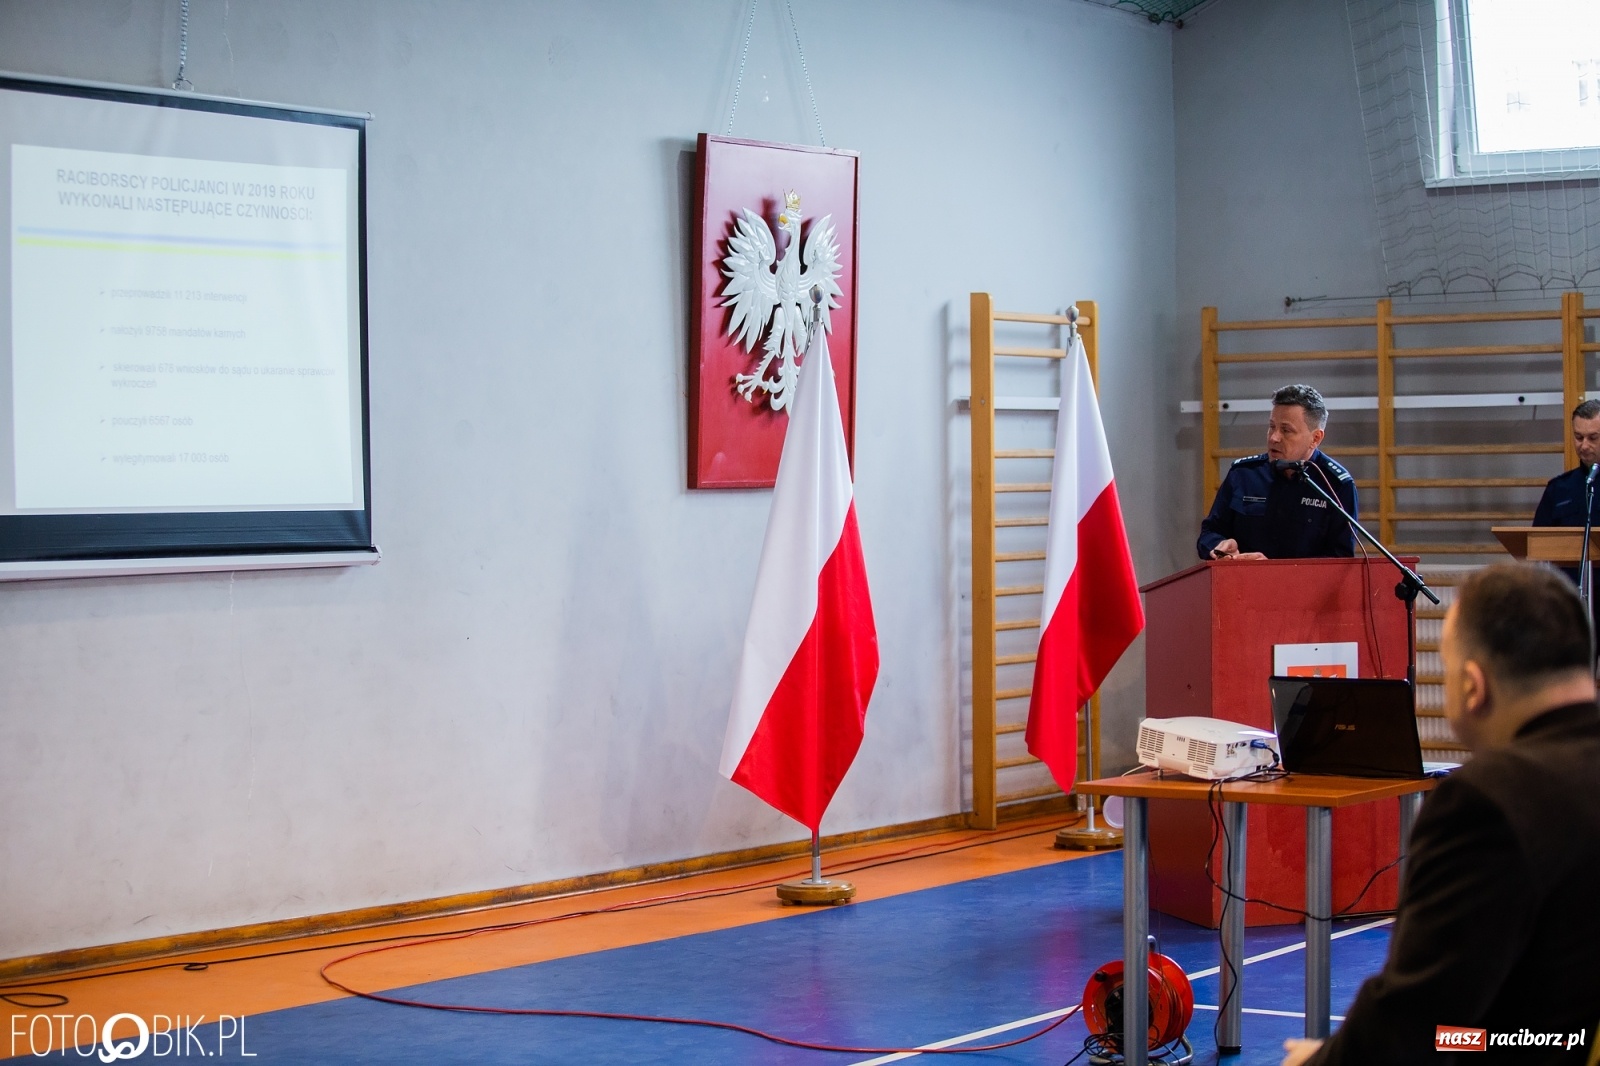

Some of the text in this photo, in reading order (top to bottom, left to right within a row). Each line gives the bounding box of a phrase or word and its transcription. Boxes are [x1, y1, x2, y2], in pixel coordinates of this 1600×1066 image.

[57, 168, 315, 201] RACIBORSCY POLICJANCI W 2019 ROKU
[58, 190, 313, 221] WYKONALI NASTĘPUJĄCE CZYNNOŚCI:
[1301, 497, 1327, 508] POLICJA
